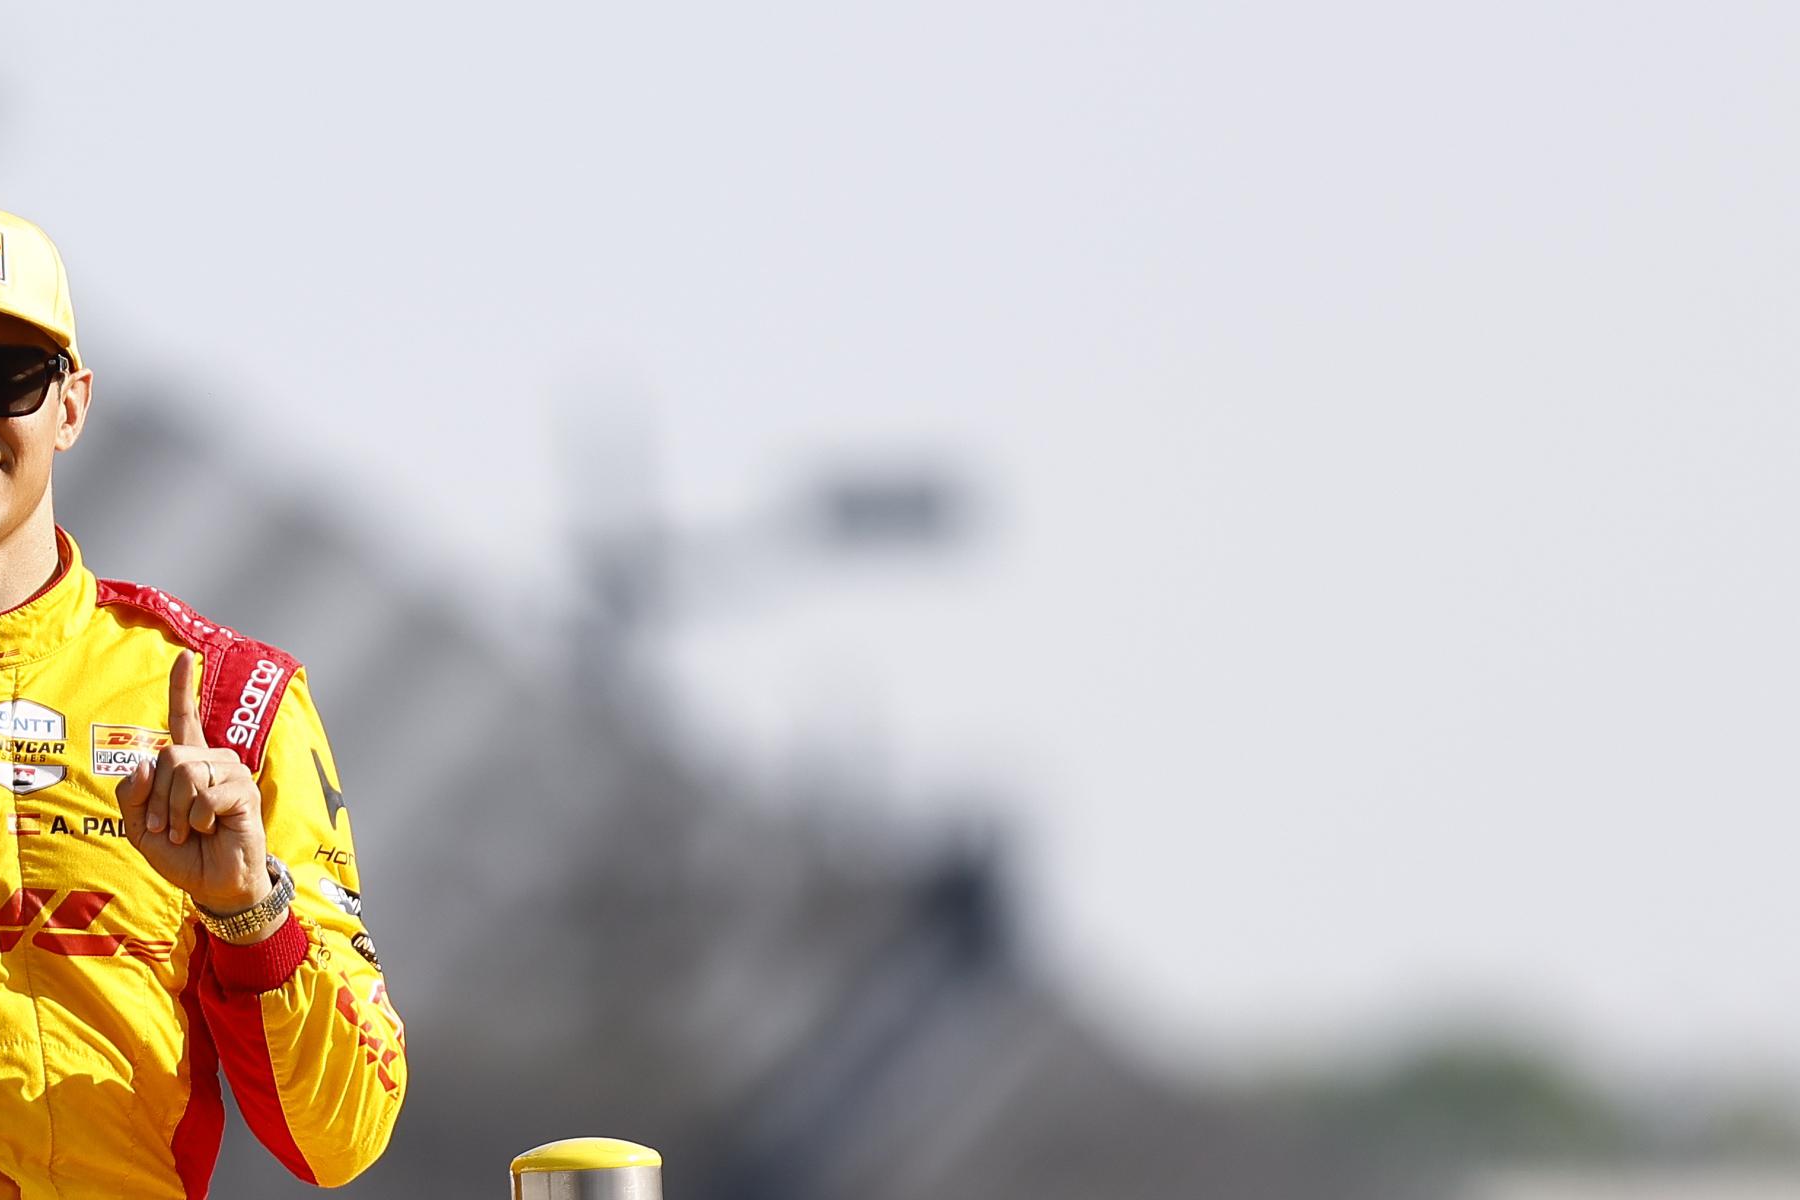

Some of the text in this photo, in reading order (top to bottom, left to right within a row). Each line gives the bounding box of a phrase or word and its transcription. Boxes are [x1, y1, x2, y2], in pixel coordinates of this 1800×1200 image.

[226, 659, 285, 749] sparco
[14, 718, 56, 733] NTT
[1, 753, 47, 763] SERIES
[50, 816, 129, 837] A. PAL
